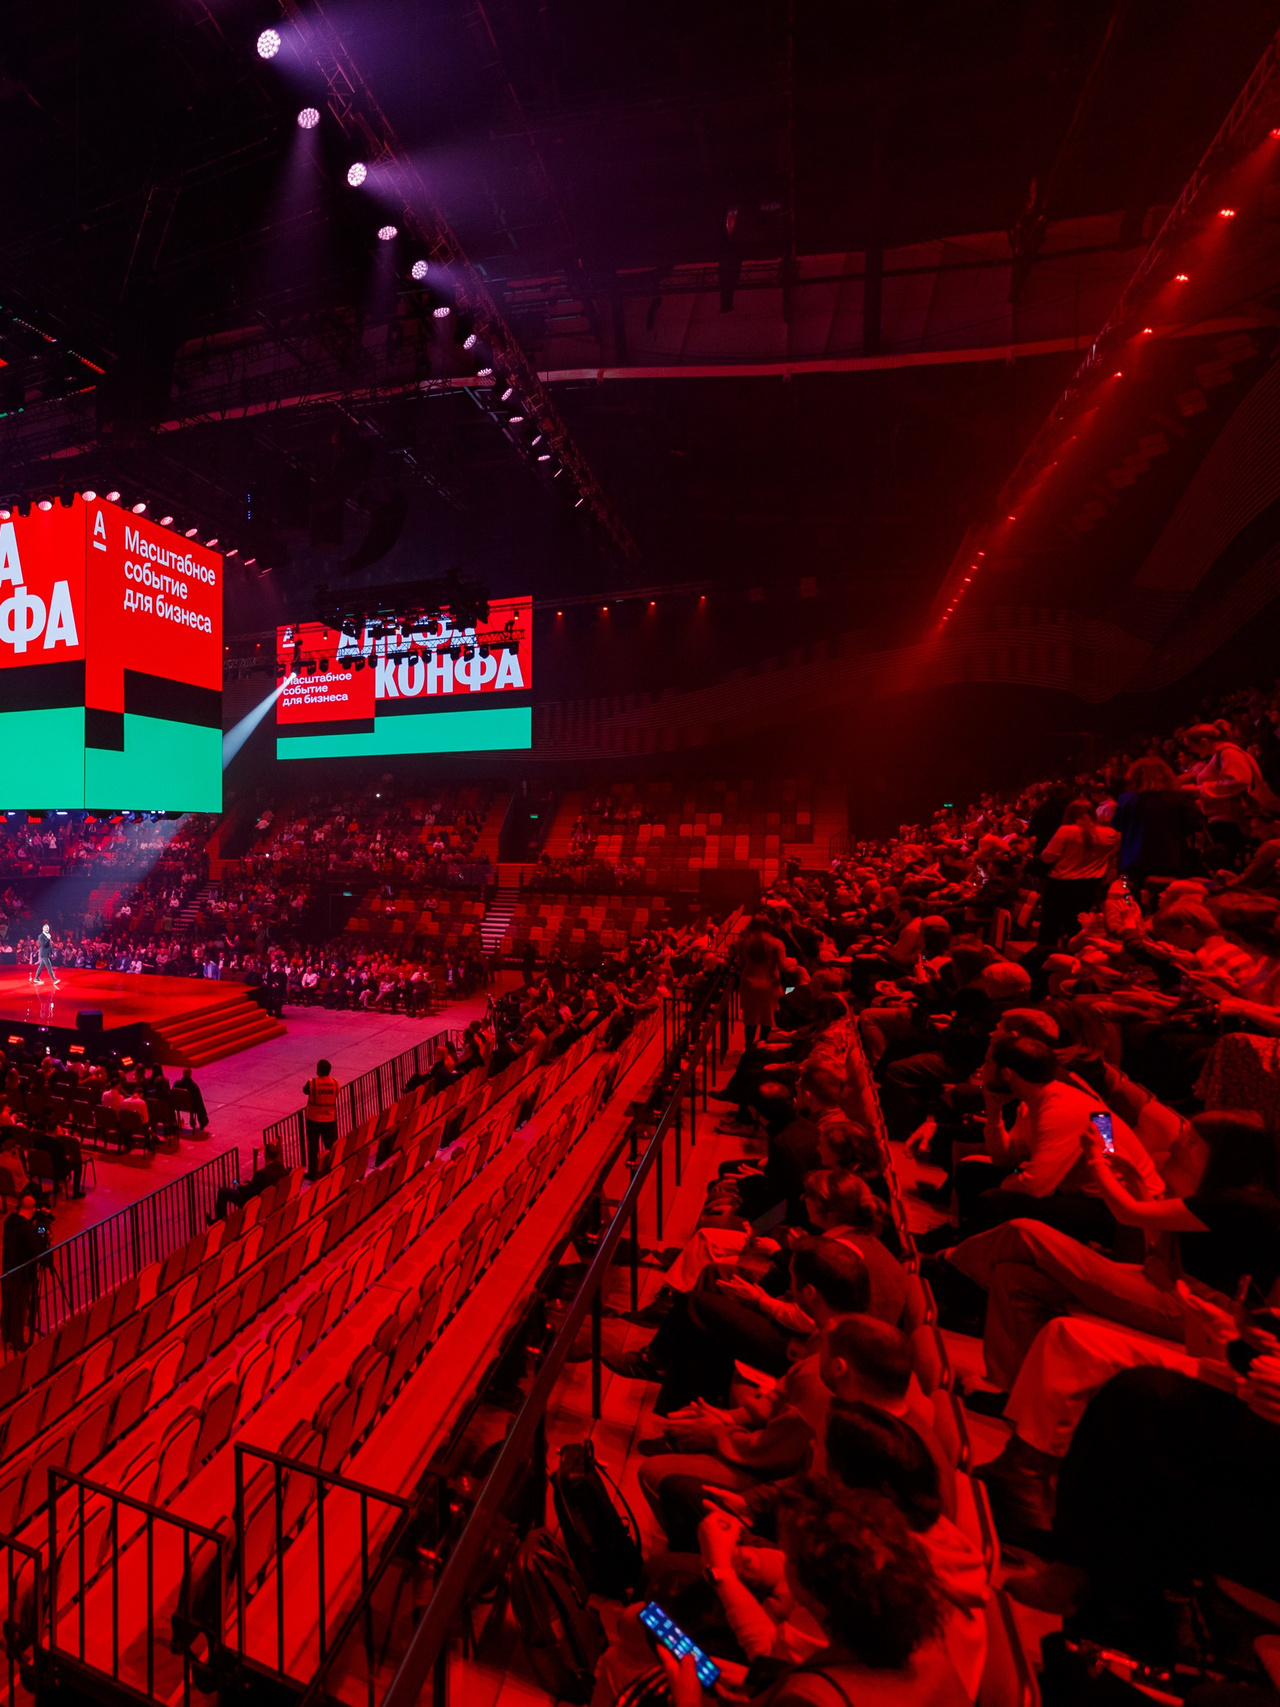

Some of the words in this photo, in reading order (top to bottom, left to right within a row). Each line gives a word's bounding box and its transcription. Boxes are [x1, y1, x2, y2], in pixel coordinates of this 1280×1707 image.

[124, 526, 216, 586] Масштабное
[124, 560, 188, 600] событие
[124, 589, 153, 614] для
[155, 595, 212, 634] бизнеса
[283, 672, 352, 685] Масштабное
[283, 685, 328, 696] событие
[375, 647, 524, 698] КОНФА
[282, 697, 303, 707] для
[304, 693, 349, 704] бизнеса
